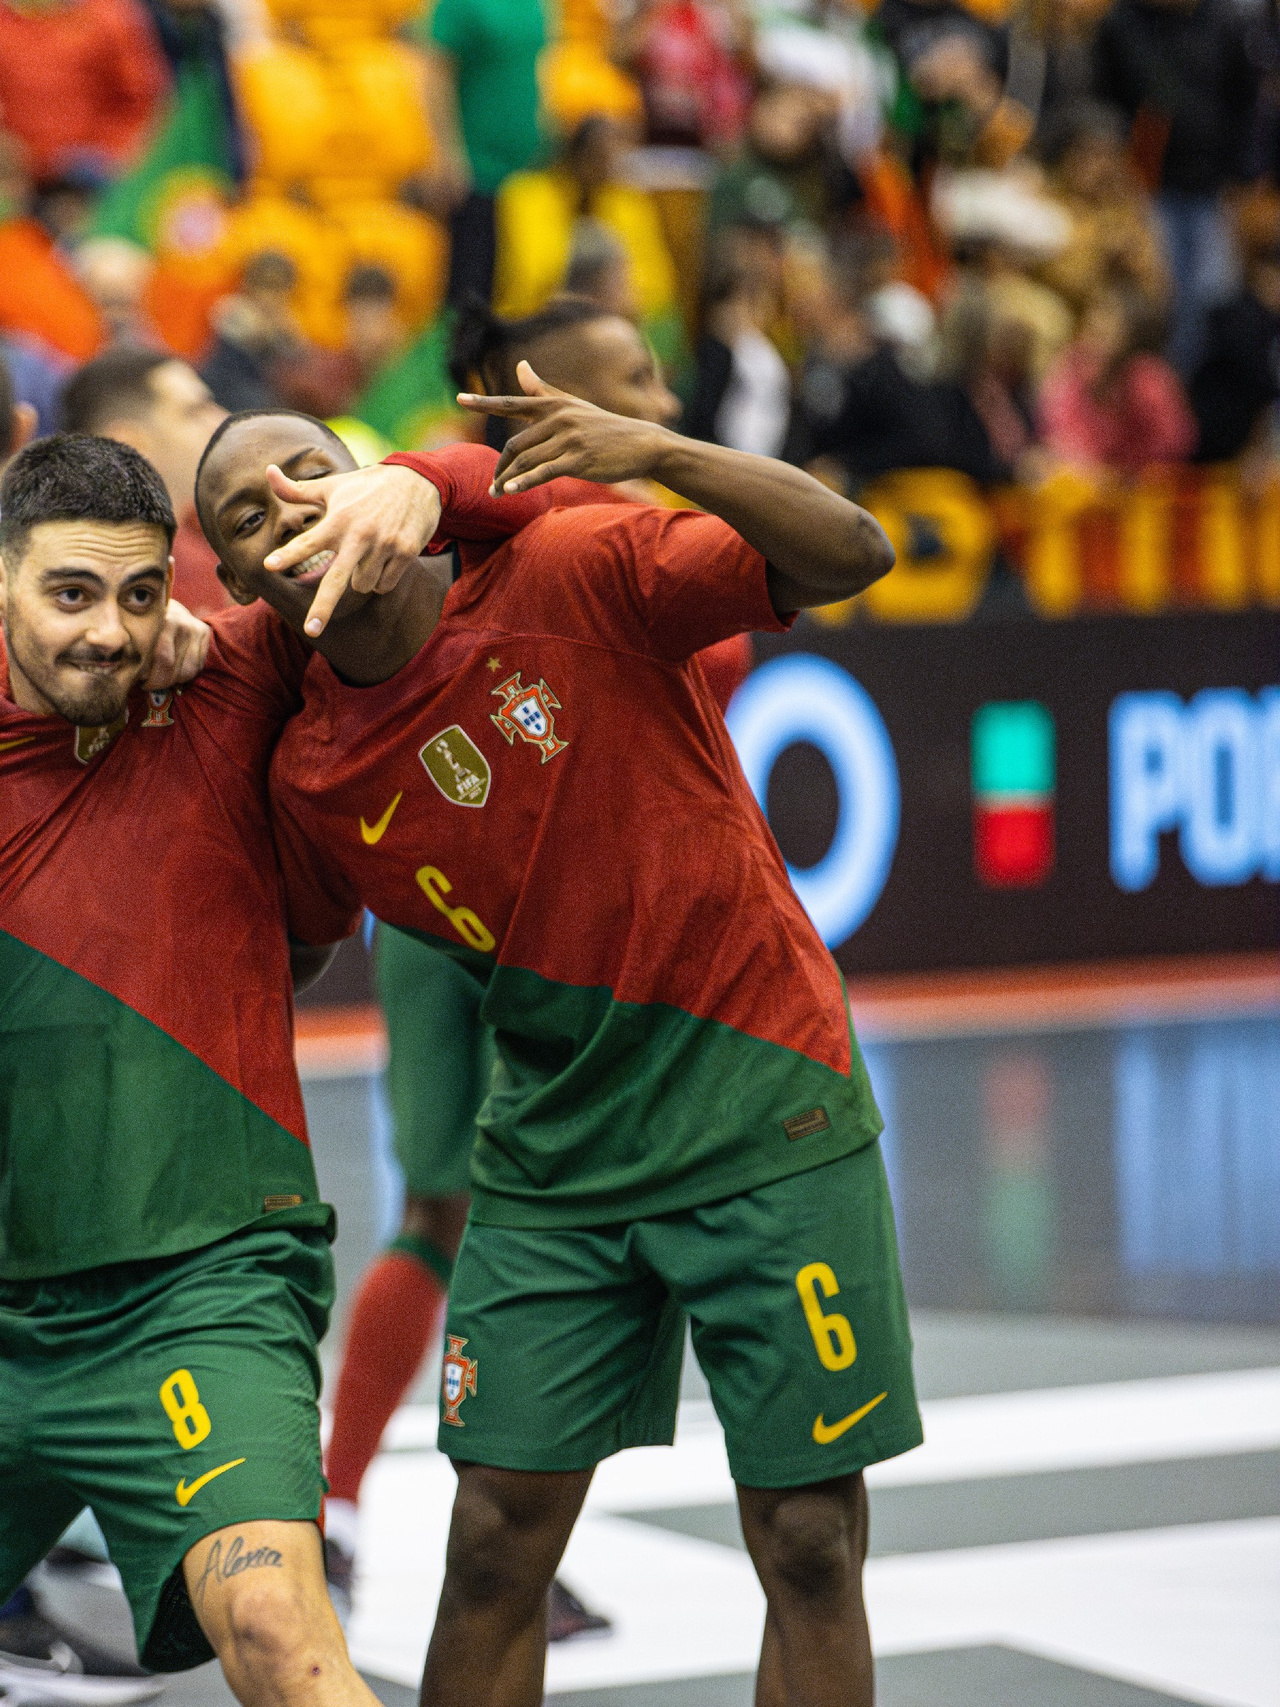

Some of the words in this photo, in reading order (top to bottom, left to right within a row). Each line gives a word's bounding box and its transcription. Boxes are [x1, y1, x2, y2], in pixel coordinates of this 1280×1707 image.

[1107, 684, 1280, 890] PO
[415, 865, 496, 952] 6
[796, 1261, 857, 1372] 6
[159, 1368, 212, 1450] 8
